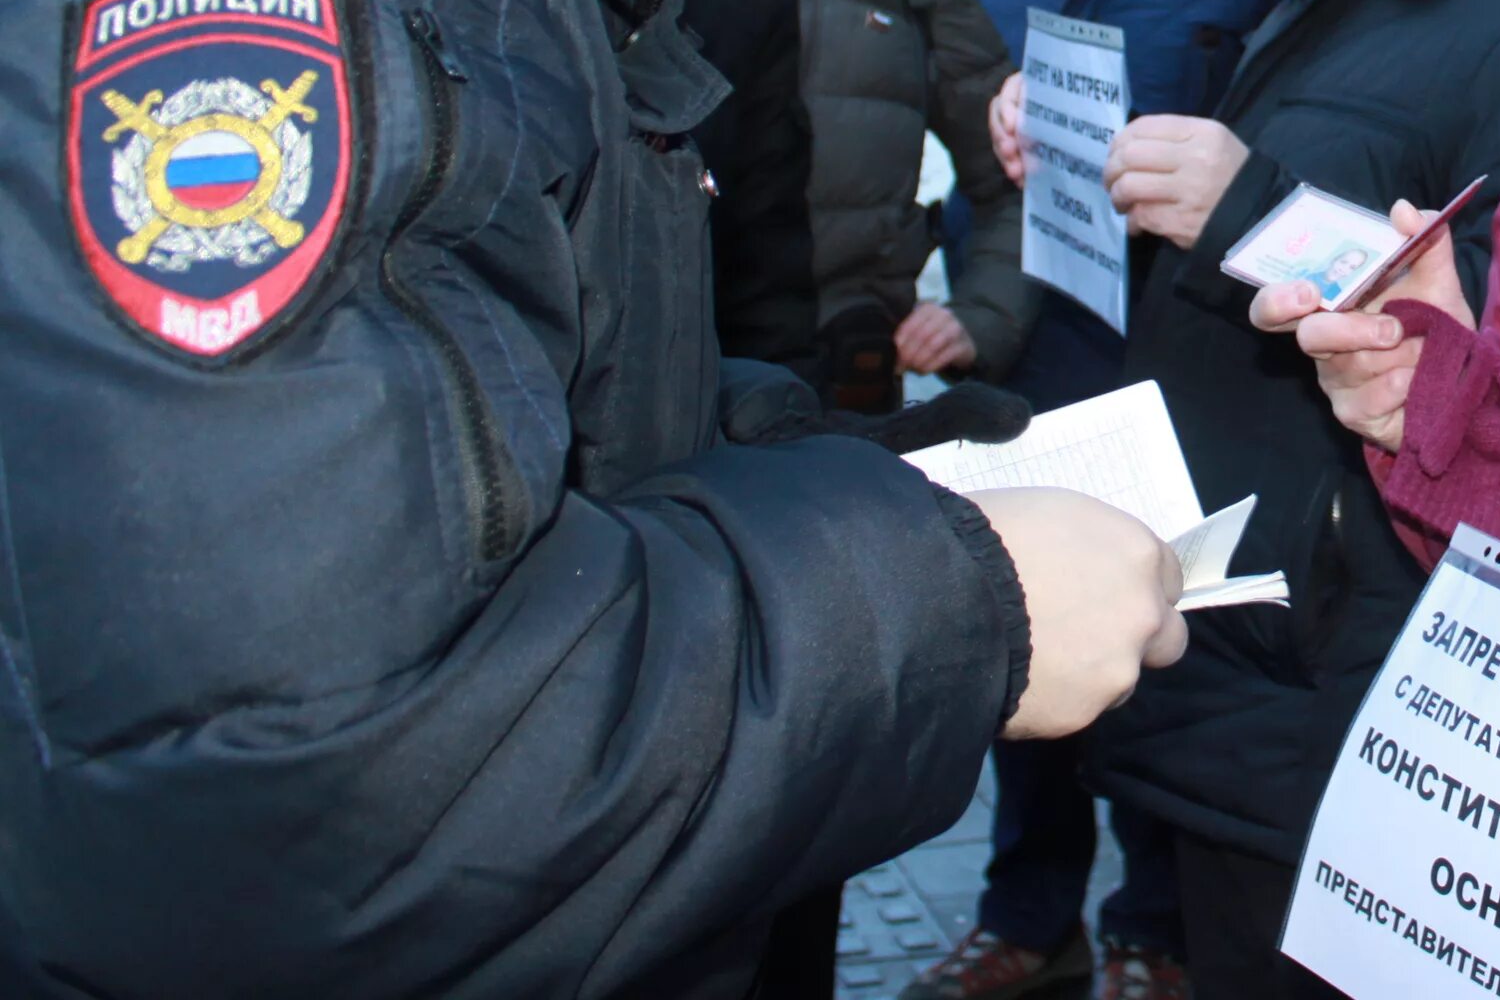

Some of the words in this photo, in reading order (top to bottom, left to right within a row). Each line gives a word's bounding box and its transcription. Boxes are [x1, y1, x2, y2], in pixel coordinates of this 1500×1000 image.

[1066, 70, 1120, 107] ВСТРЕЧИ
[160, 290, 261, 349] МВД
[1394, 674, 1413, 699] С
